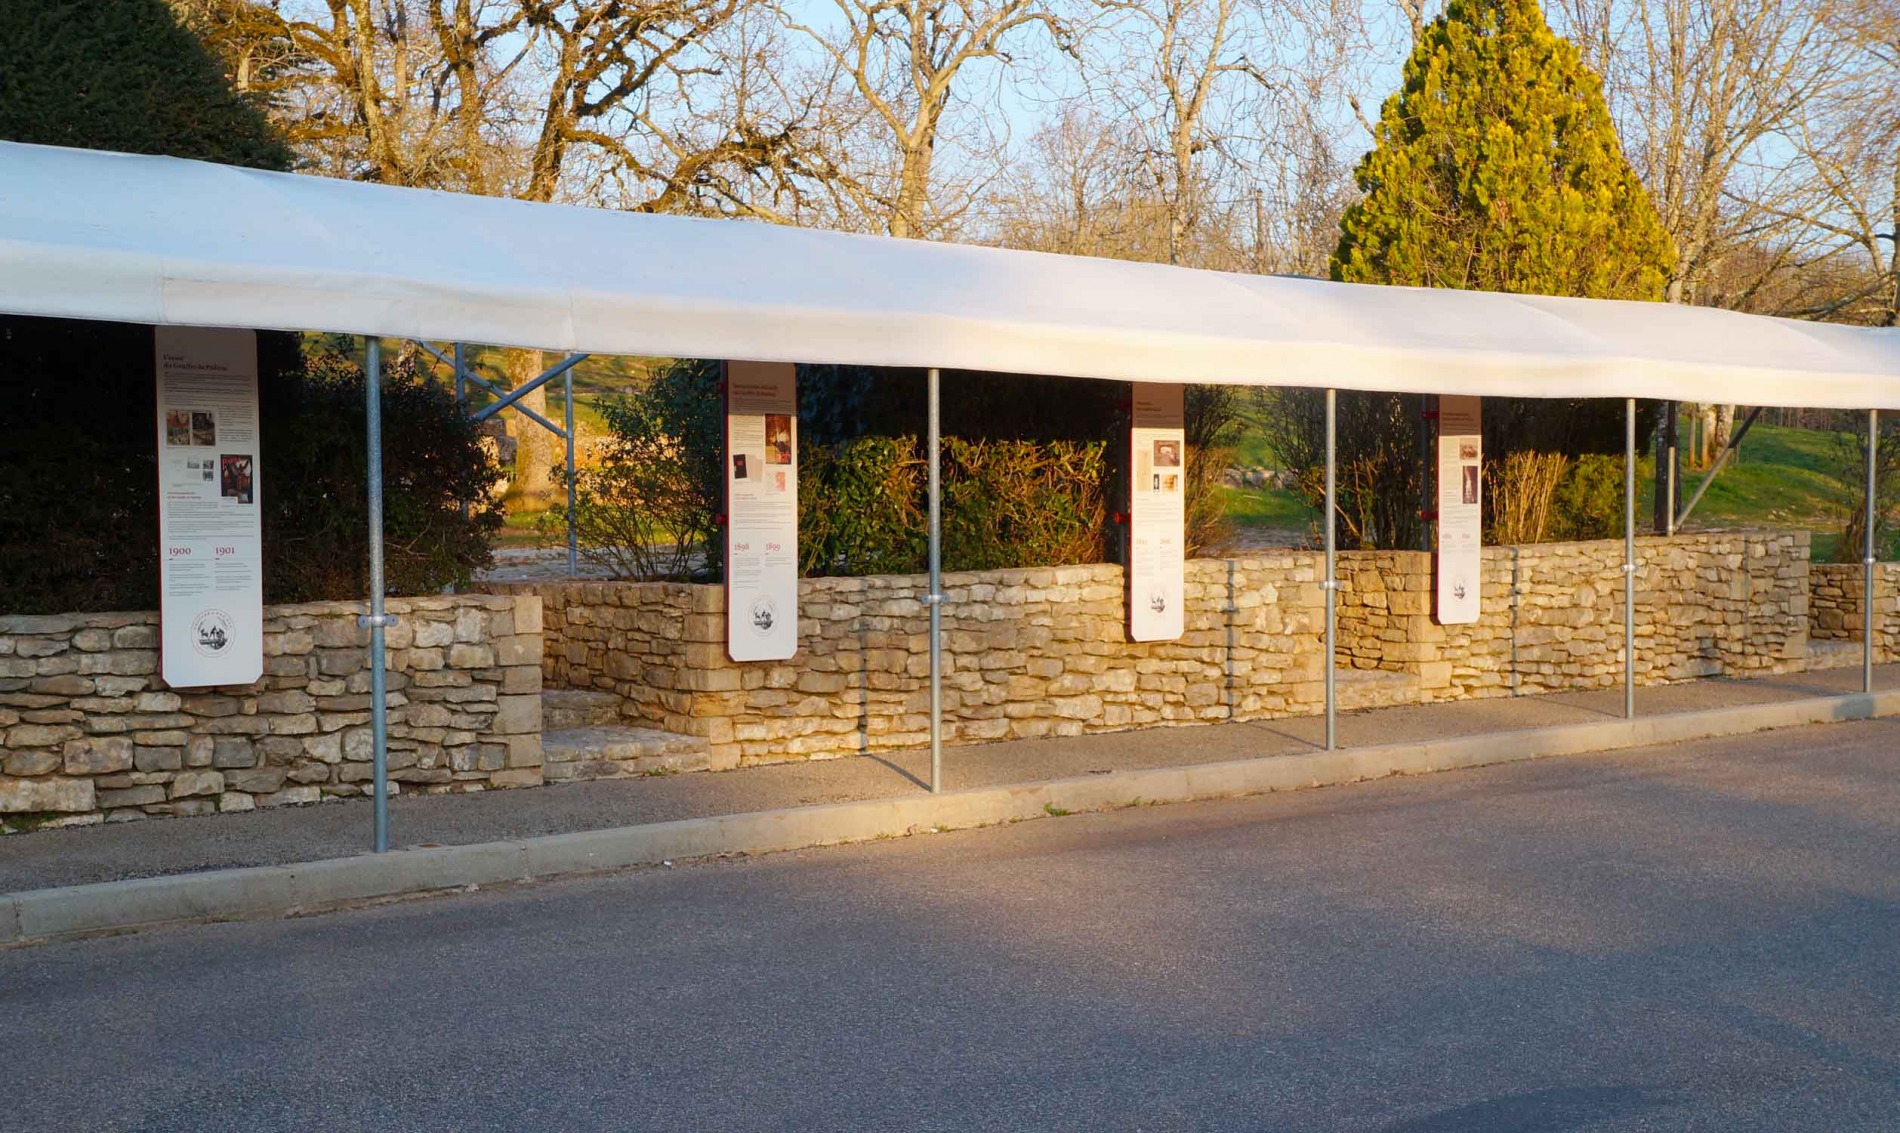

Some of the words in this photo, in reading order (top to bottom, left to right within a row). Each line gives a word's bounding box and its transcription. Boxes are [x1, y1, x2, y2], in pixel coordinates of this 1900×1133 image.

[169, 547, 192, 557] 1900
[215, 547, 235, 556] 1901
[734, 542, 750, 552] 1898
[766, 542, 781, 552] 1899
